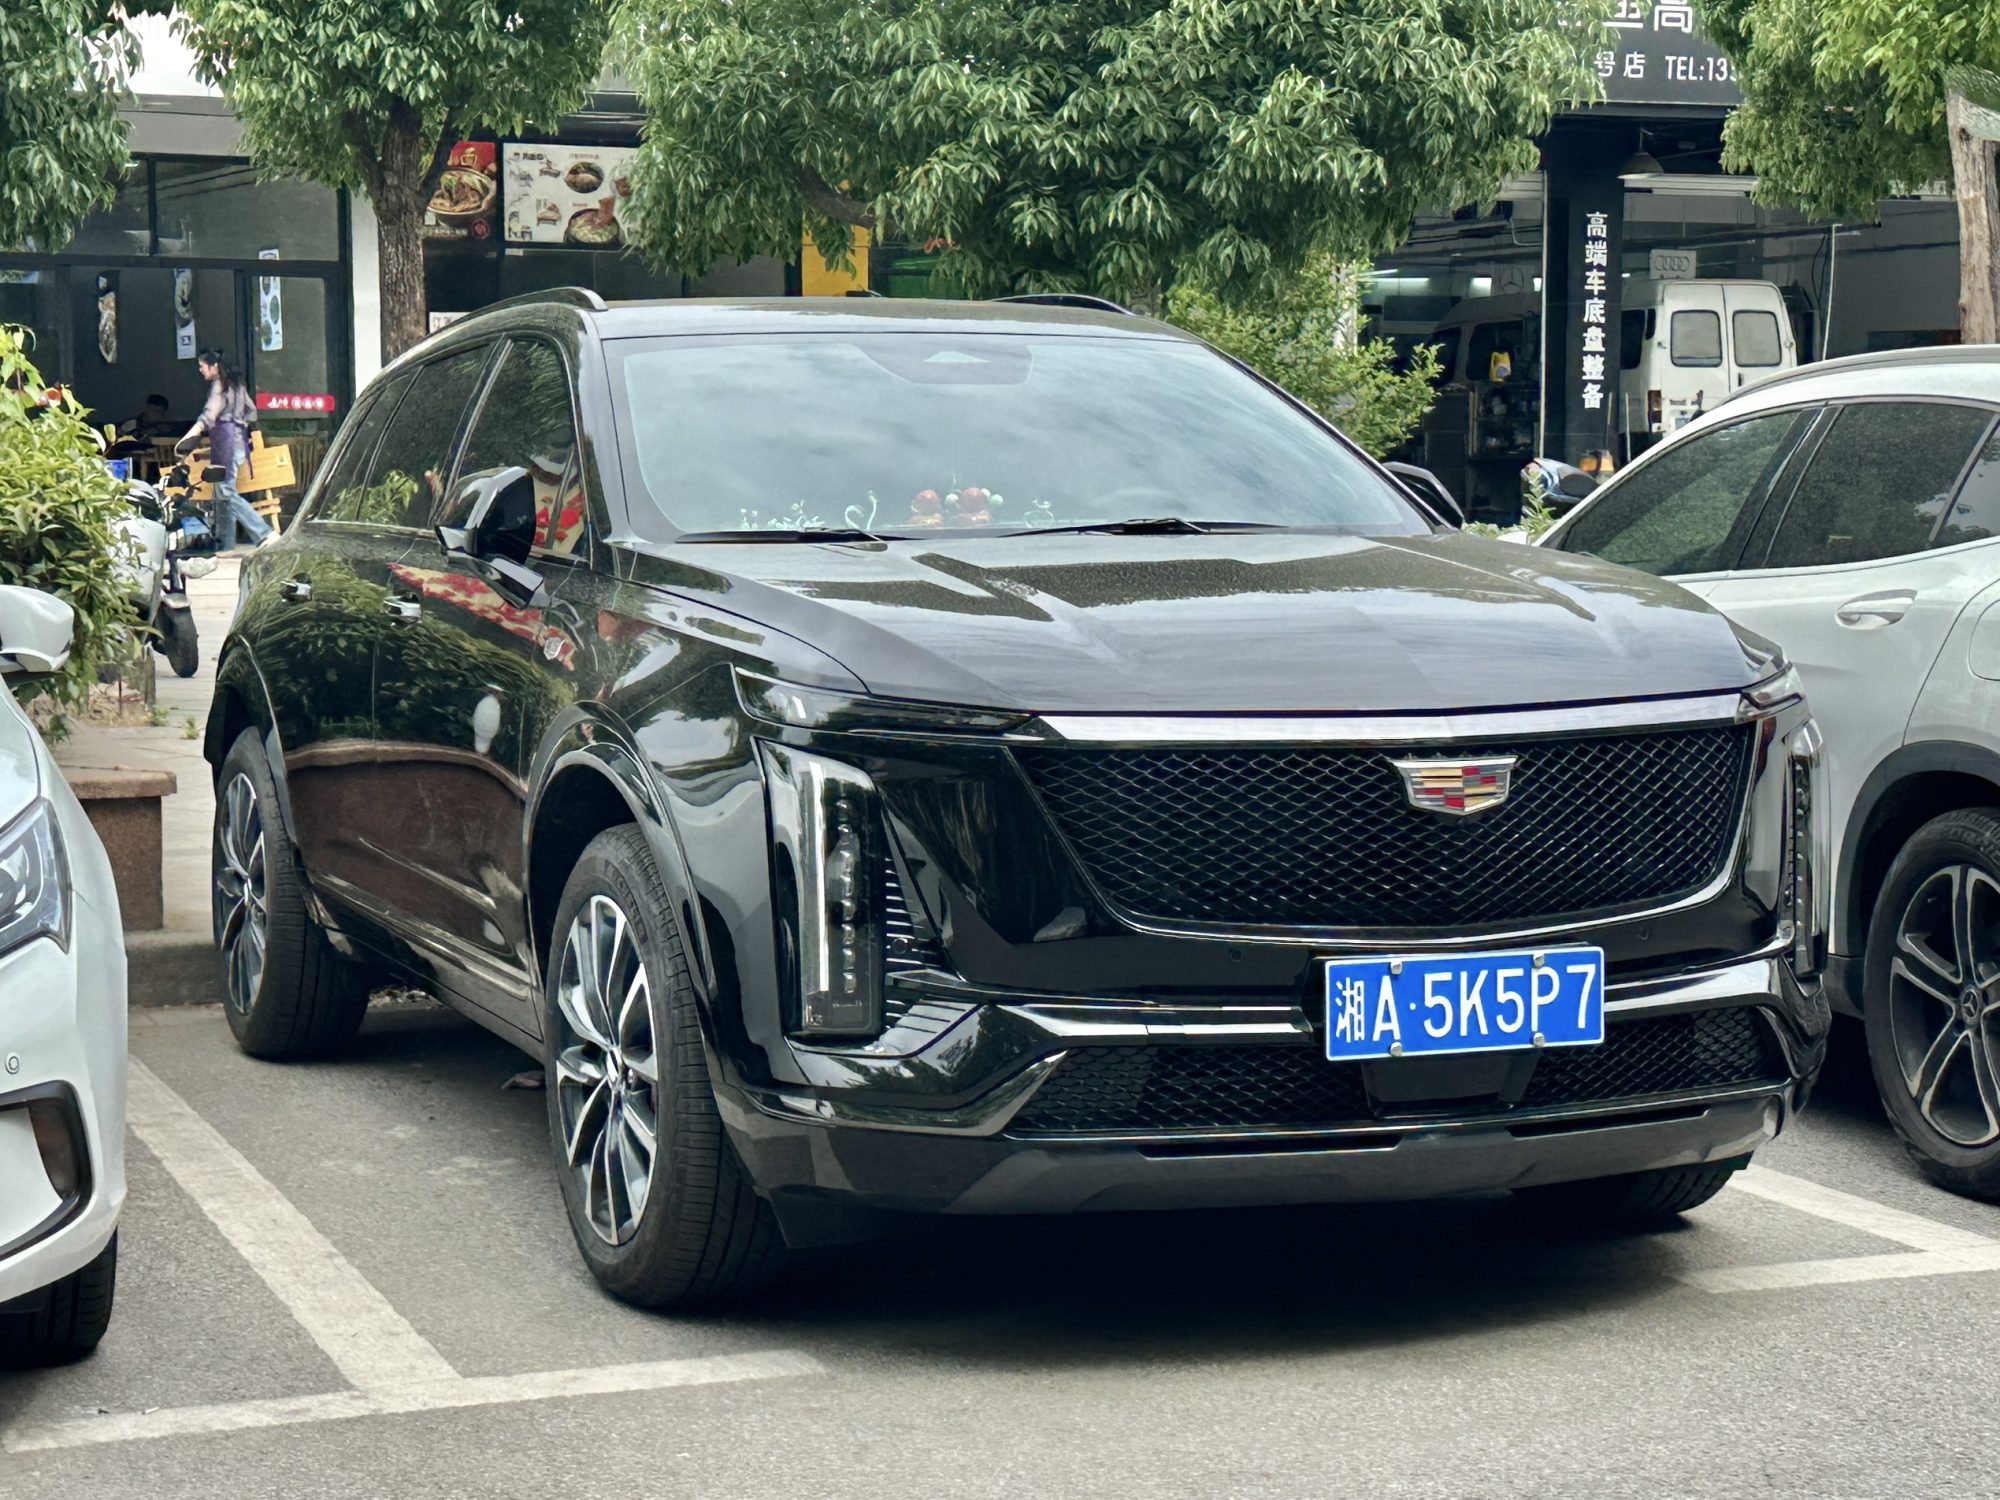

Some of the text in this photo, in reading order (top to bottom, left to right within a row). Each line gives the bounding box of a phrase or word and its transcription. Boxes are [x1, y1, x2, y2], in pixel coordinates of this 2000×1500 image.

[1582, 211, 1608, 409] 高端车底盘整备
